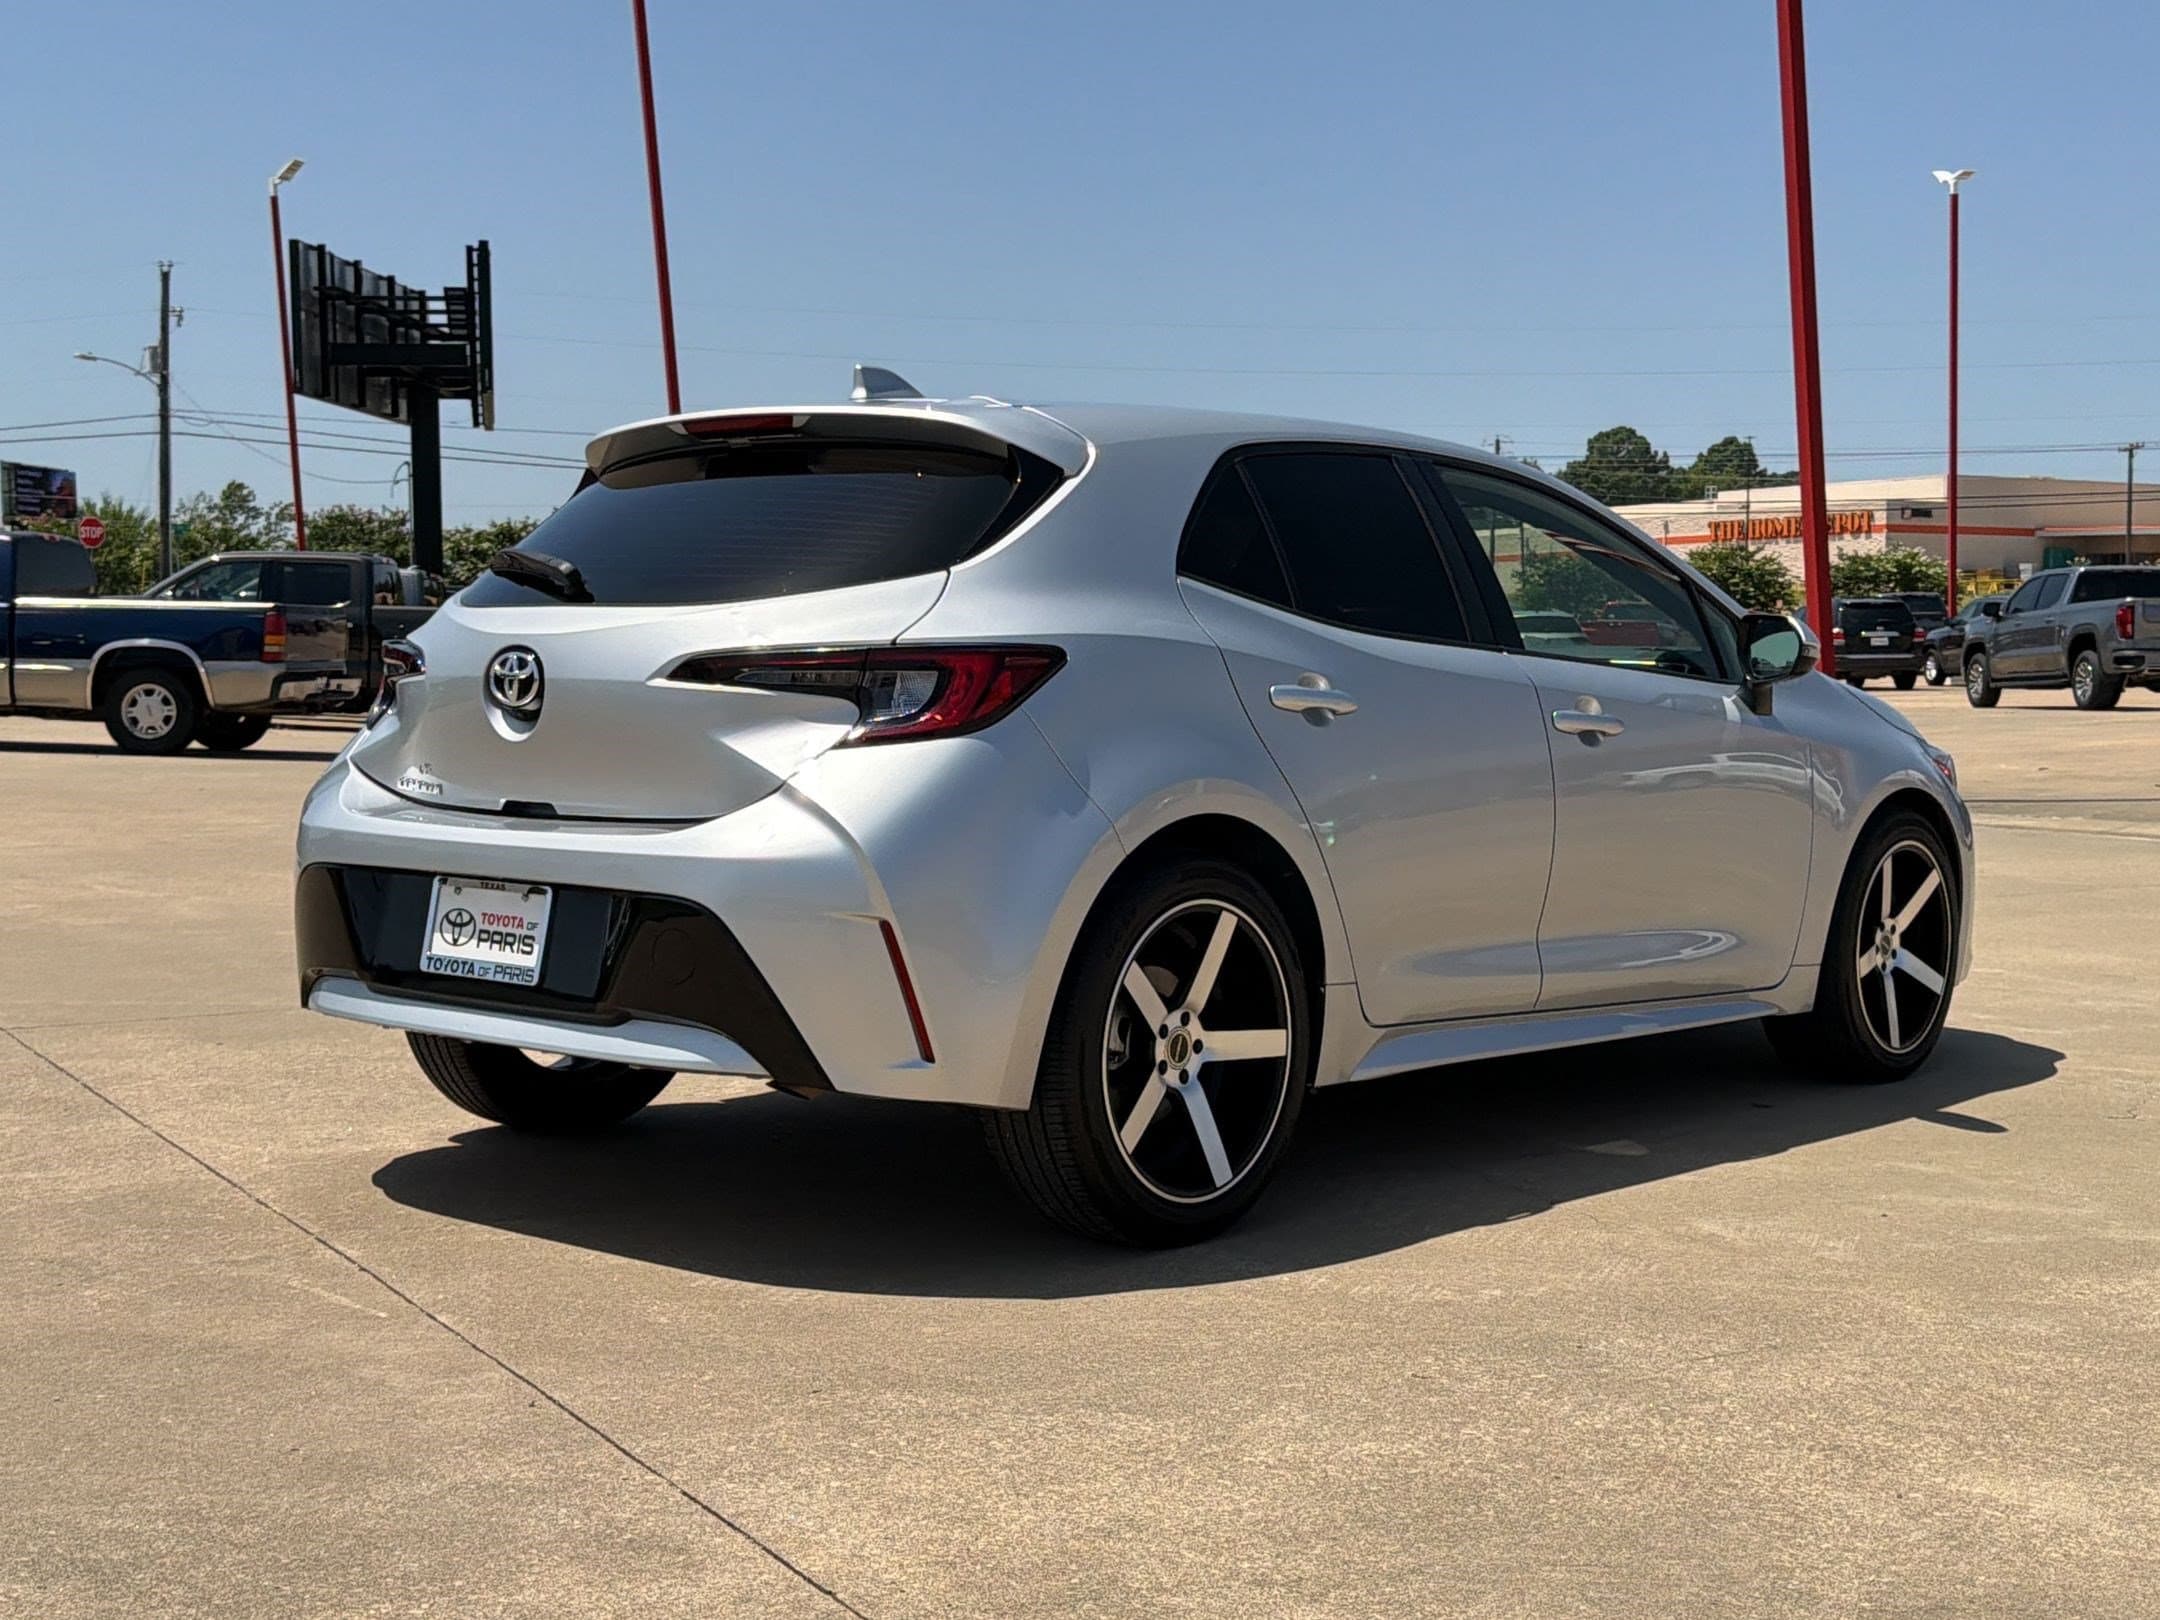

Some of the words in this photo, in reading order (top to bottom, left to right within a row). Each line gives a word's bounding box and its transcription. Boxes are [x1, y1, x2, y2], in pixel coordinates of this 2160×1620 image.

[80, 526, 103, 539] STOP
[1708, 520, 1744, 541] THE
[1748, 516, 1801, 539] HOME
[480, 881, 507, 891] TEXAS
[481, 912, 524, 930] TOYOTA
[526, 921, 539, 931] OF
[476, 929, 536, 956] PARIS
[426, 956, 475, 976] TOYOTA
[477, 966, 492, 977] OF
[493, 965, 535, 984] PARIS
